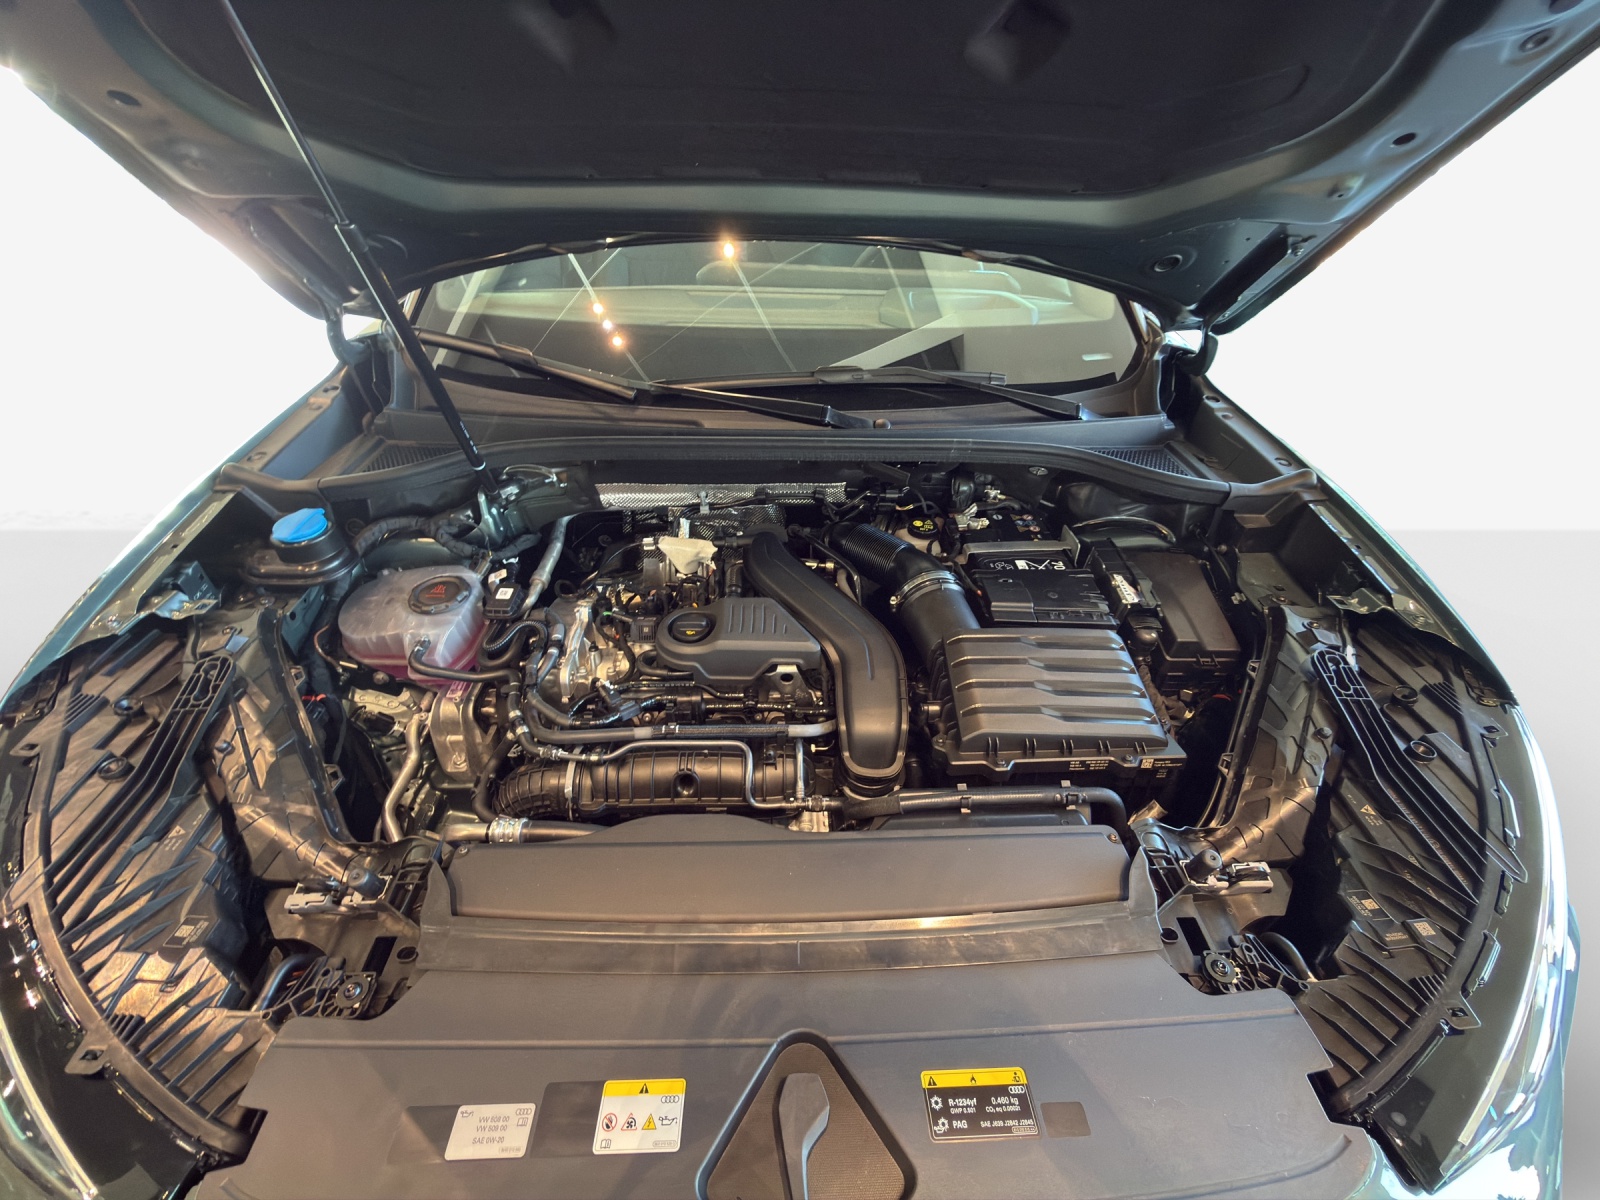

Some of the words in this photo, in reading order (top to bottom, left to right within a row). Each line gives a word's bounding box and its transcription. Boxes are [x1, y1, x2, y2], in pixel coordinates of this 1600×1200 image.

[1009, 1096, 1019, 1105] kg
[499, 1124, 508, 1132] 00
[952, 1120, 968, 1129] PAG
[980, 1120, 991, 1128] SAE
